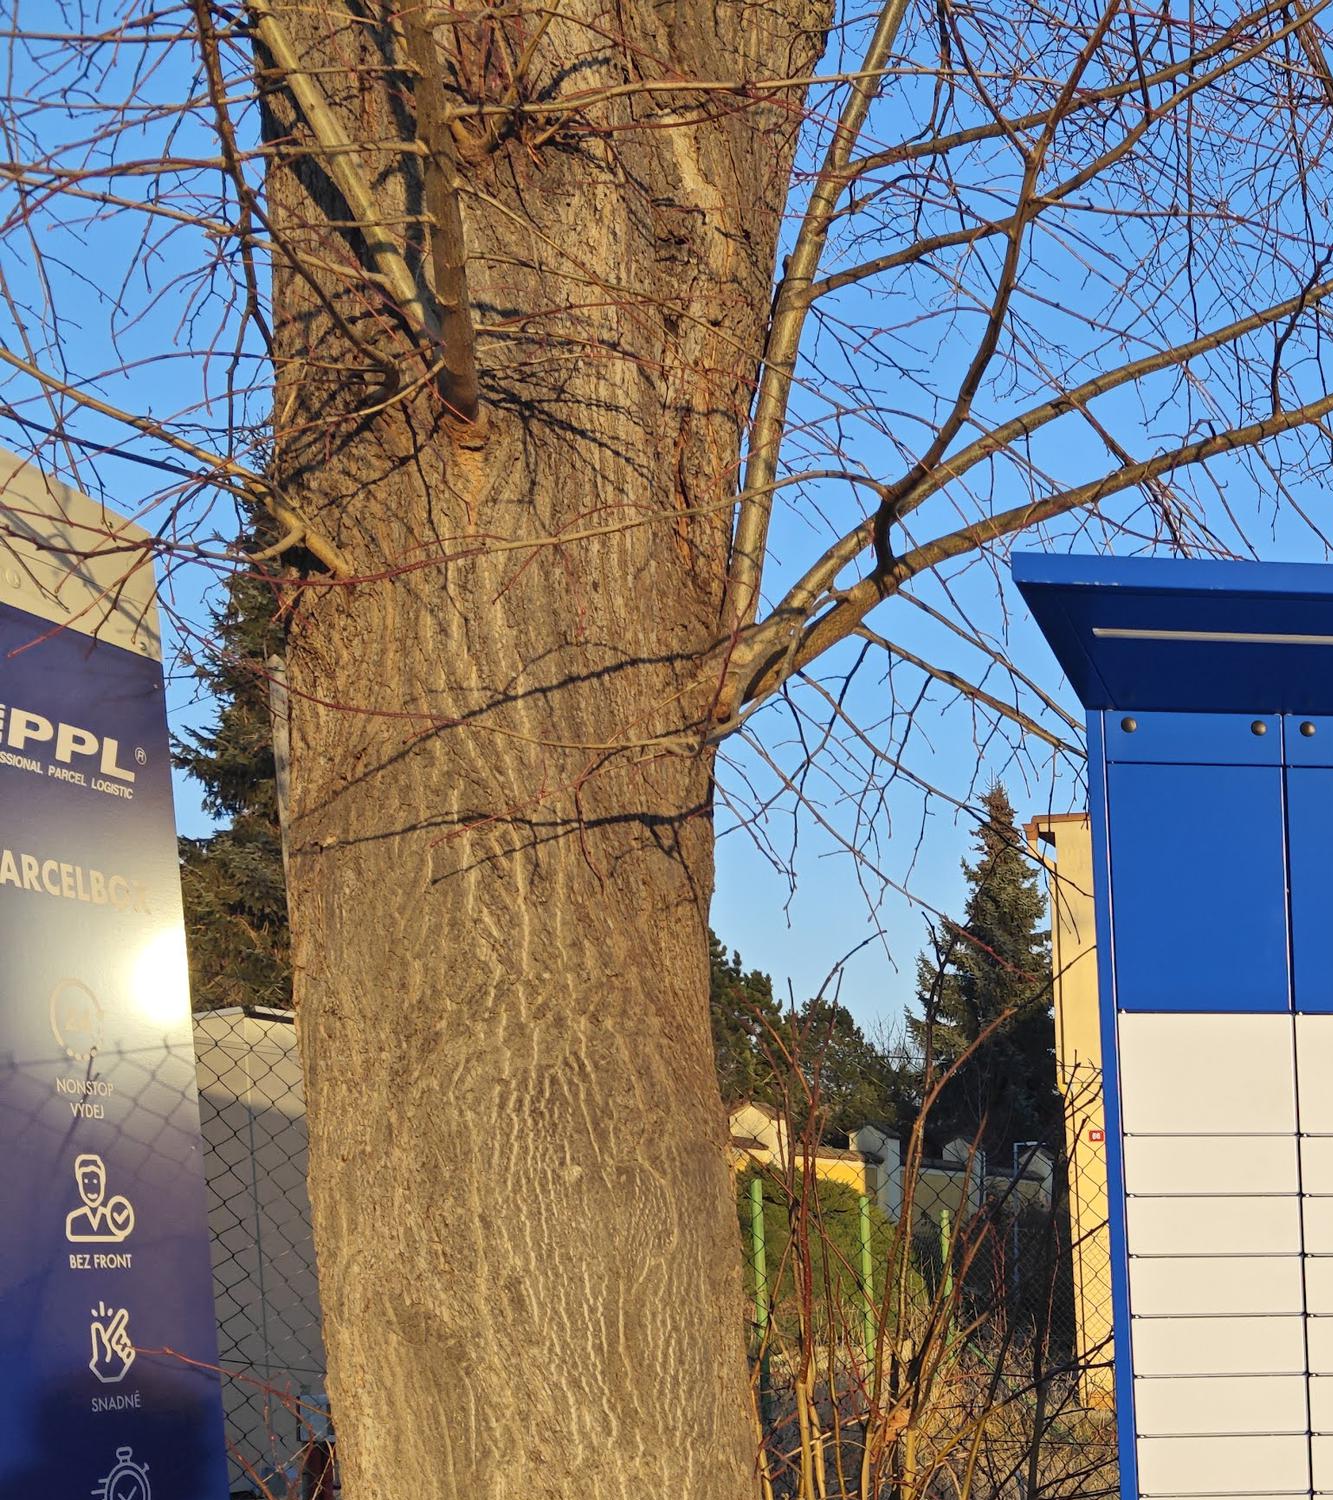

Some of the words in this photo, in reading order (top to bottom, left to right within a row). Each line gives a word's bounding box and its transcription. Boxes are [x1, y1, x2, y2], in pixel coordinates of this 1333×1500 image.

[47, 764, 88, 787] PARCEL
[91, 777, 134, 800] LOGISTIC
[55, 1076, 114, 1097] NONSTOP
[68, 1253, 92, 1270] BEZ
[93, 1253, 133, 1270] FRONT
[91, 1390, 142, 1412] SNADNÉ
